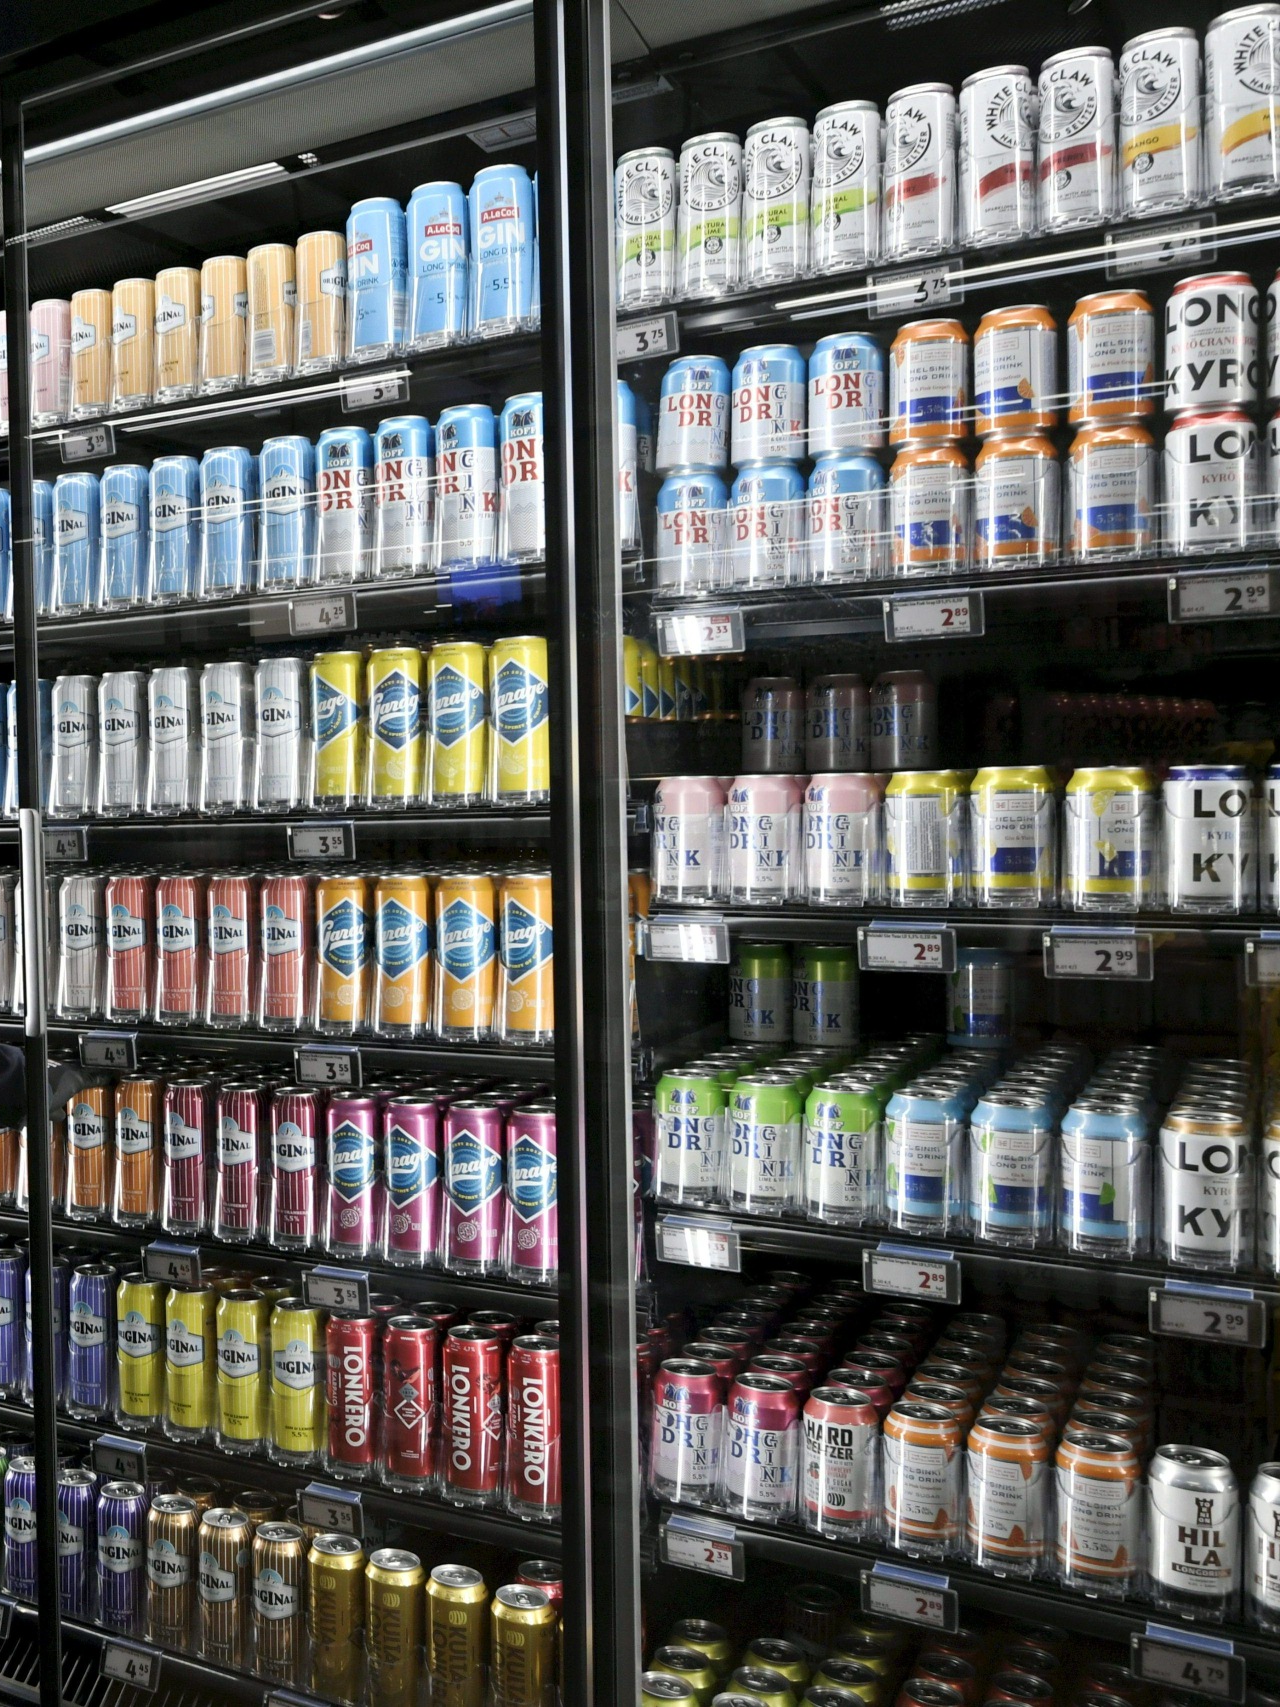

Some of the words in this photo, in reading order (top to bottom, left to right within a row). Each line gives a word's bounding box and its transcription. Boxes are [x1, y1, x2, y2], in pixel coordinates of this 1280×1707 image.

[1131, 50, 1177, 68] CLAW
[1234, 26, 1264, 75] WHITE
[1050, 69, 1093, 87] CLAW
[985, 86, 1012, 131] WHITE
[1147, 77, 1178, 117] SELTZER
[1066, 96, 1095, 134] SELTZER
[835, 145, 862, 179] SELTZER
[478, 222, 526, 248] GIN
[420, 238, 468, 261] GIN
[1095, 338, 1144, 349] HELSINI
[909, 365, 952, 375] HELSINK
[326, 458, 353, 468] KOFF
[370, 692, 419, 728] Garag
[344, 1345, 365, 1447] LONKERO
[451, 1364, 472, 1471] LONKERO
[522, 1377, 545, 1487] LONKERO
[807, 1419, 853, 1447] HARD
[1178, 1525, 1226, 1548] HIL
[1184, 1547, 1222, 1567] LA
